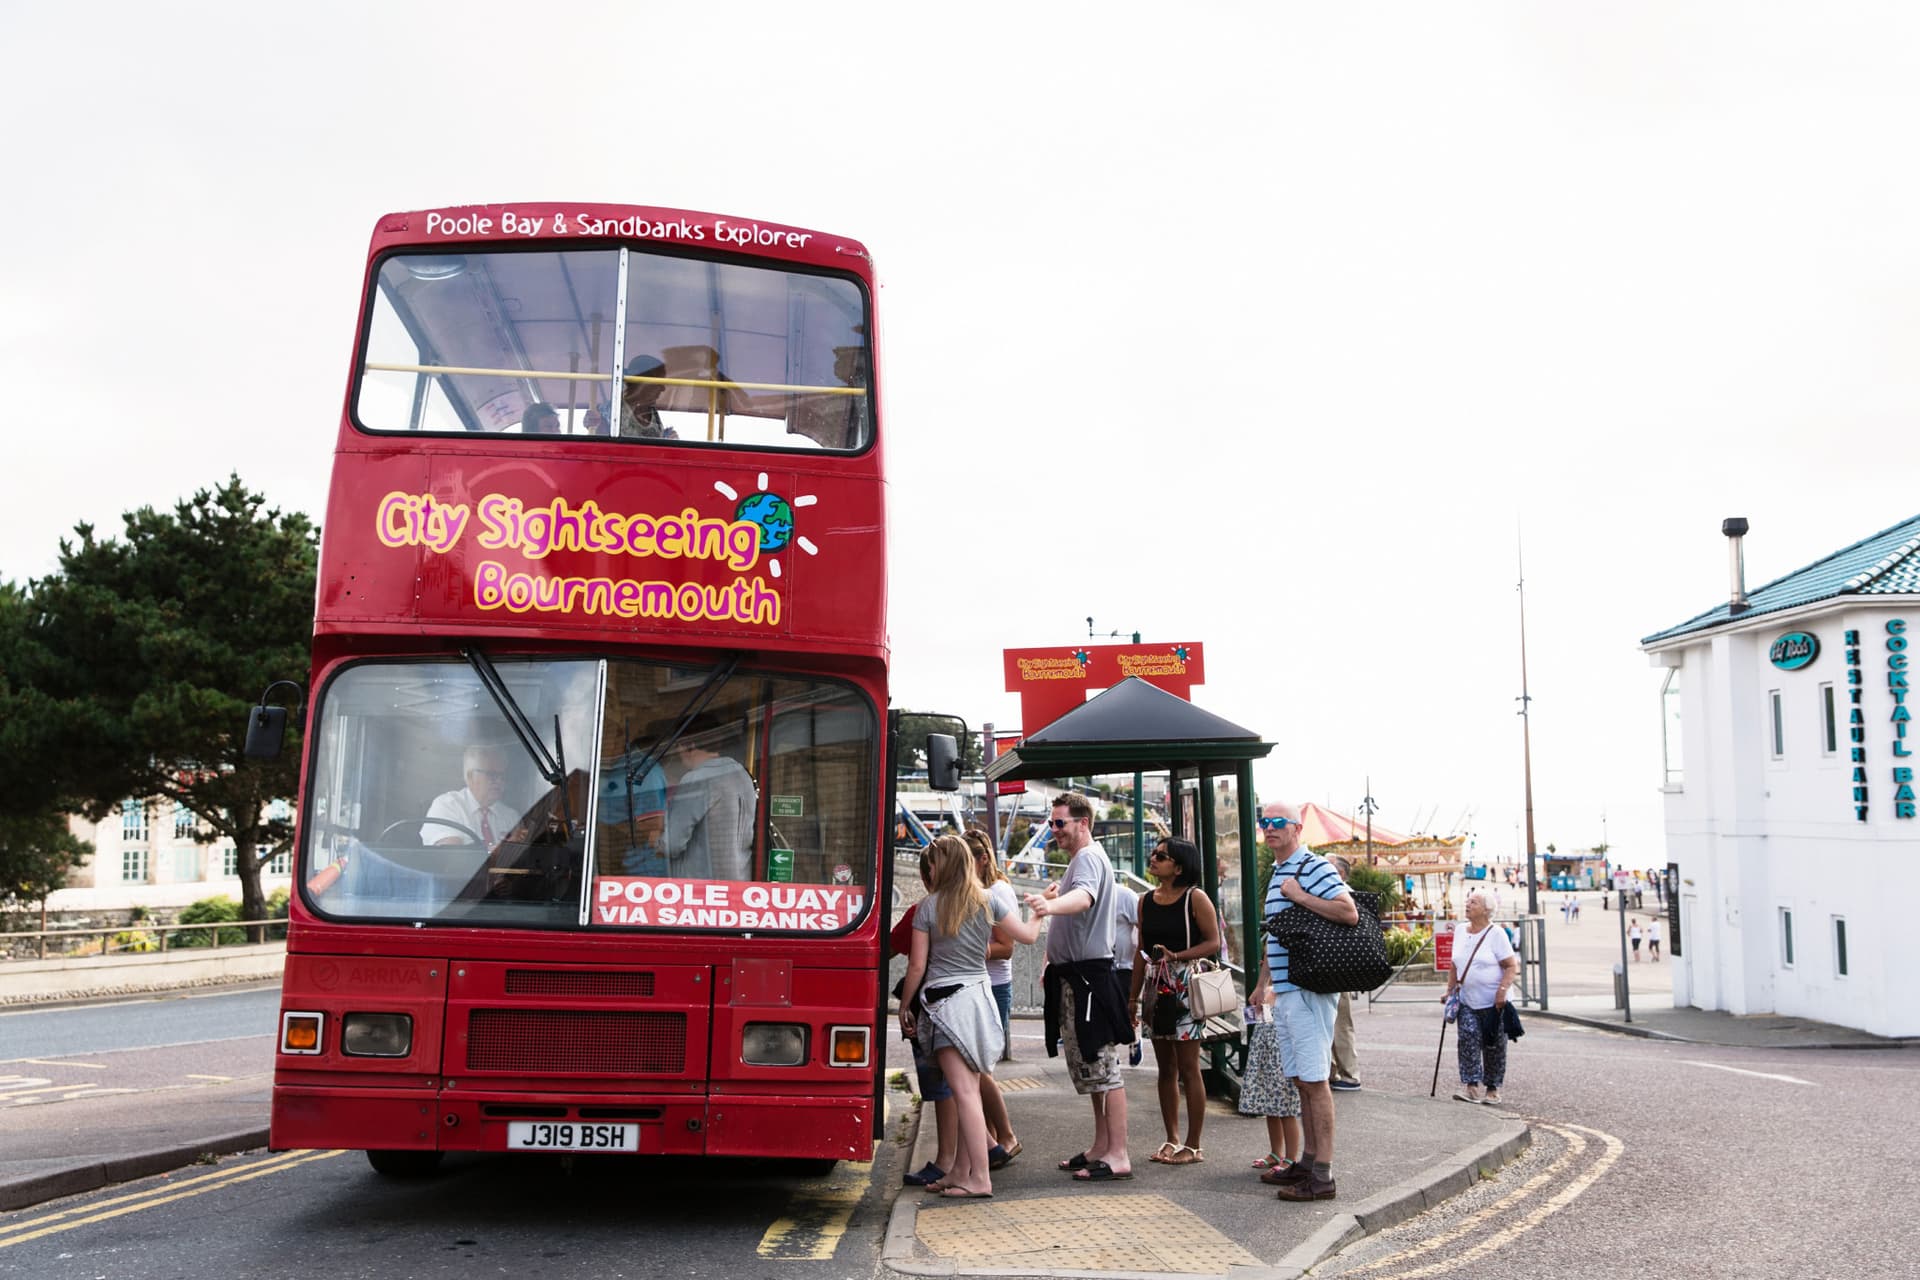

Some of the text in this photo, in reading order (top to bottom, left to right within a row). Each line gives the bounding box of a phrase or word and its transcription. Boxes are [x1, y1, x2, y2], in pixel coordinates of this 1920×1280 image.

[426, 212, 813, 248] Poole Bay & Sandbanks Explorer
[376, 490, 761, 572] City Sightseeing
[474, 560, 781, 625] Bournemouth
[1845, 630, 1868, 821] RESTAURANT
[1886, 619, 1916, 819] COCKTAIL BAR
[600, 881, 844, 910] POOLE QUAY
[600, 906, 840, 931] VIA SANDBANKS
[350, 967, 422, 985] ARRIVA
[522, 1124, 625, 1148] J319 BSH
